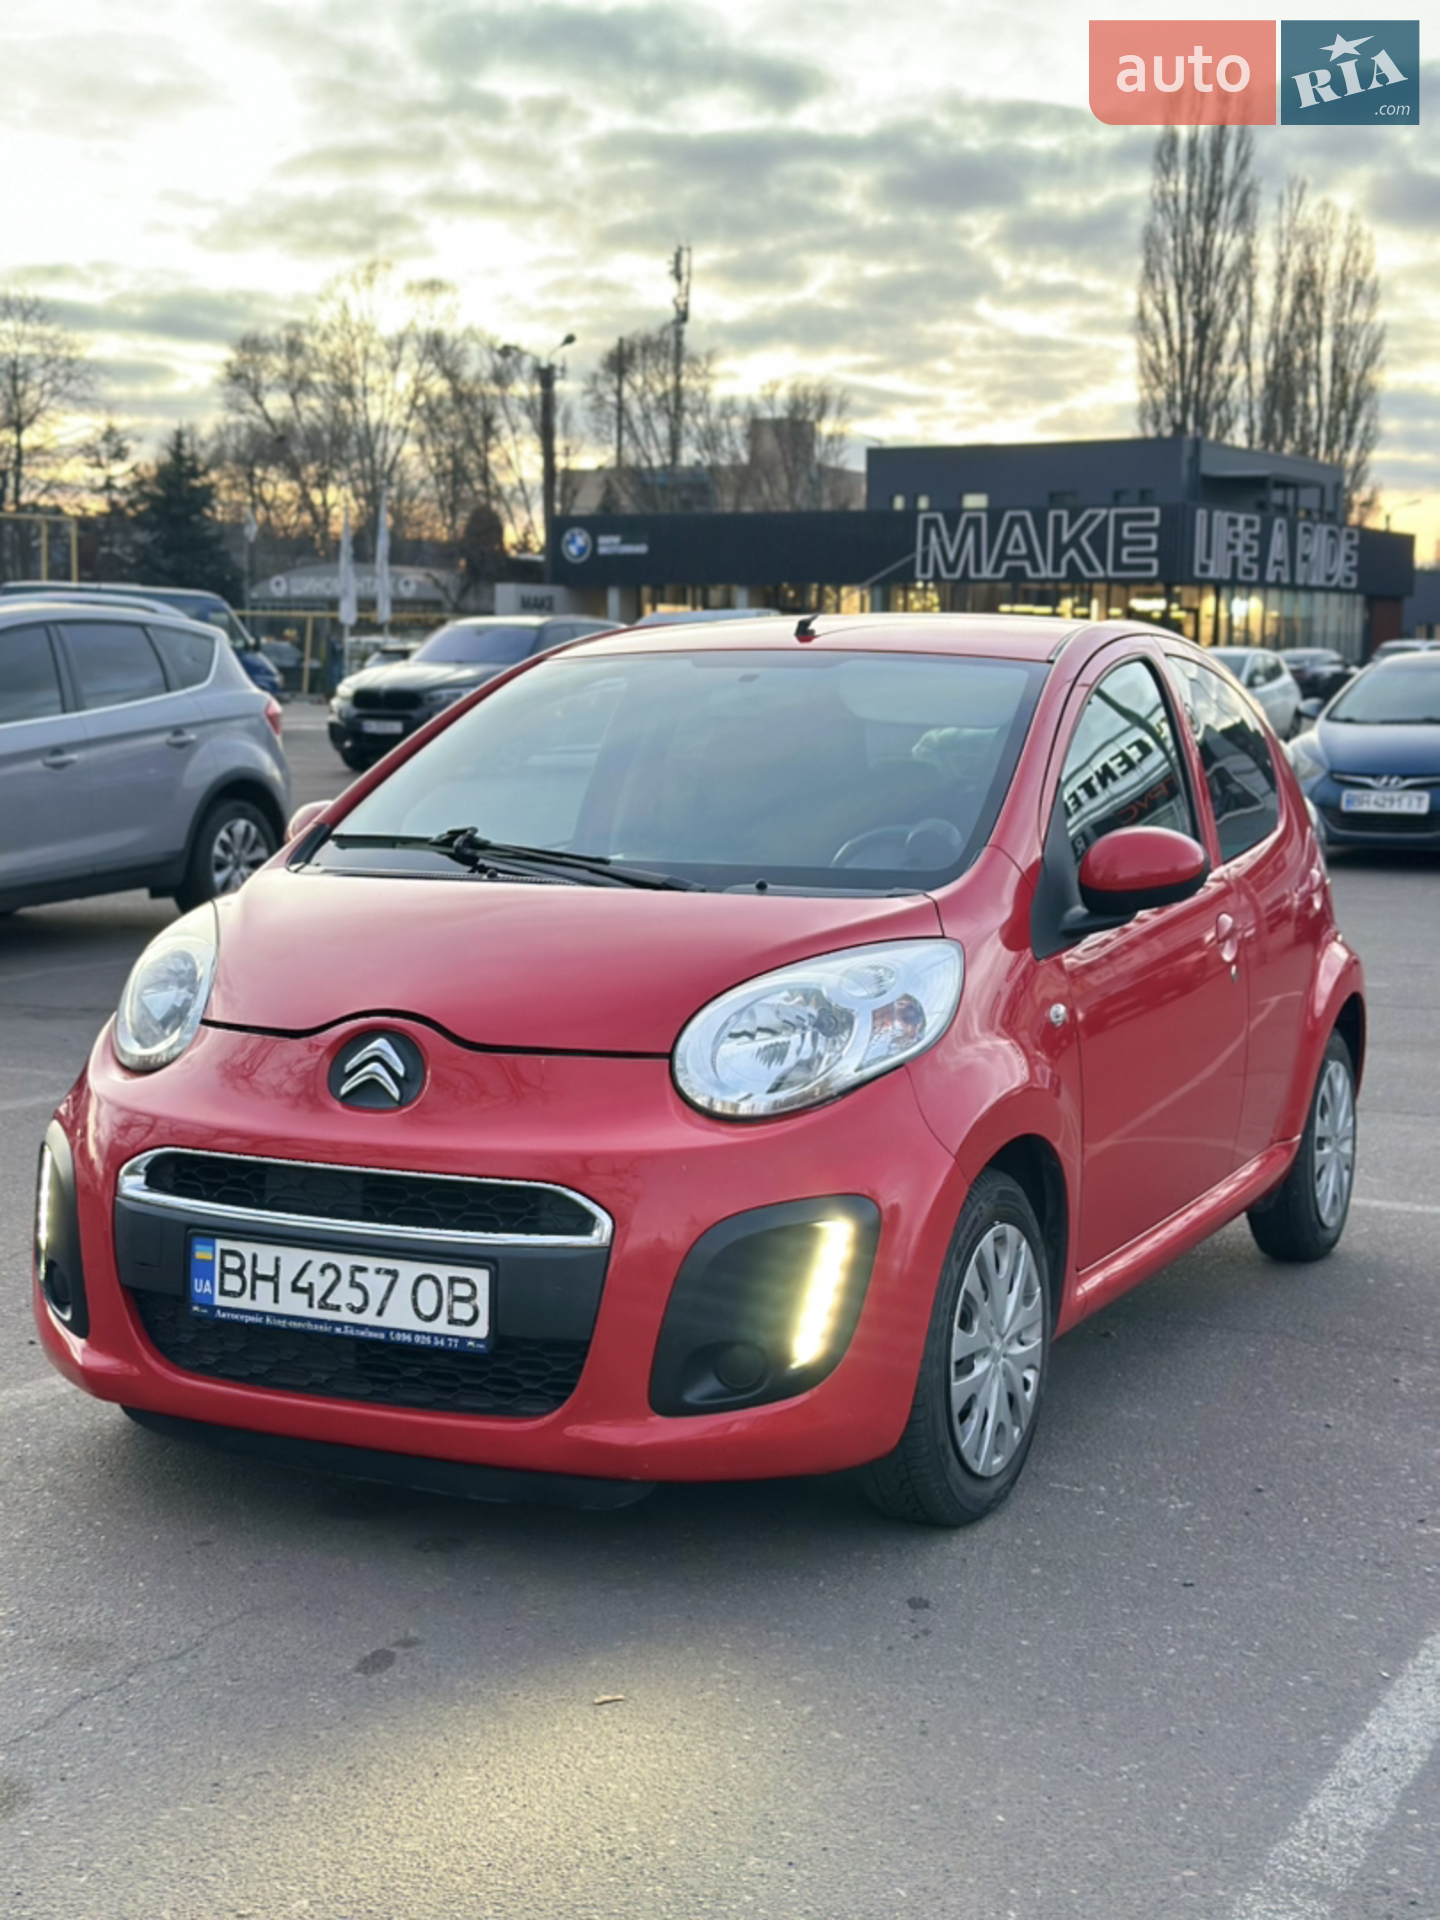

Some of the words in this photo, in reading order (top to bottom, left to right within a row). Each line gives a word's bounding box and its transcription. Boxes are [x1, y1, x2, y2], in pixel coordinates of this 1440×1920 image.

[915, 507, 1161, 580] MAKE
[1193, 508, 1261, 582] LIFE
[1264, 517, 1291, 584] A
[1294, 520, 1360, 589] RIDE
[194, 1278, 212, 1295] UA
[218, 1247, 281, 1305] BH
[290, 1259, 400, 1318] 4257
[410, 1272, 480, 1328] OB
